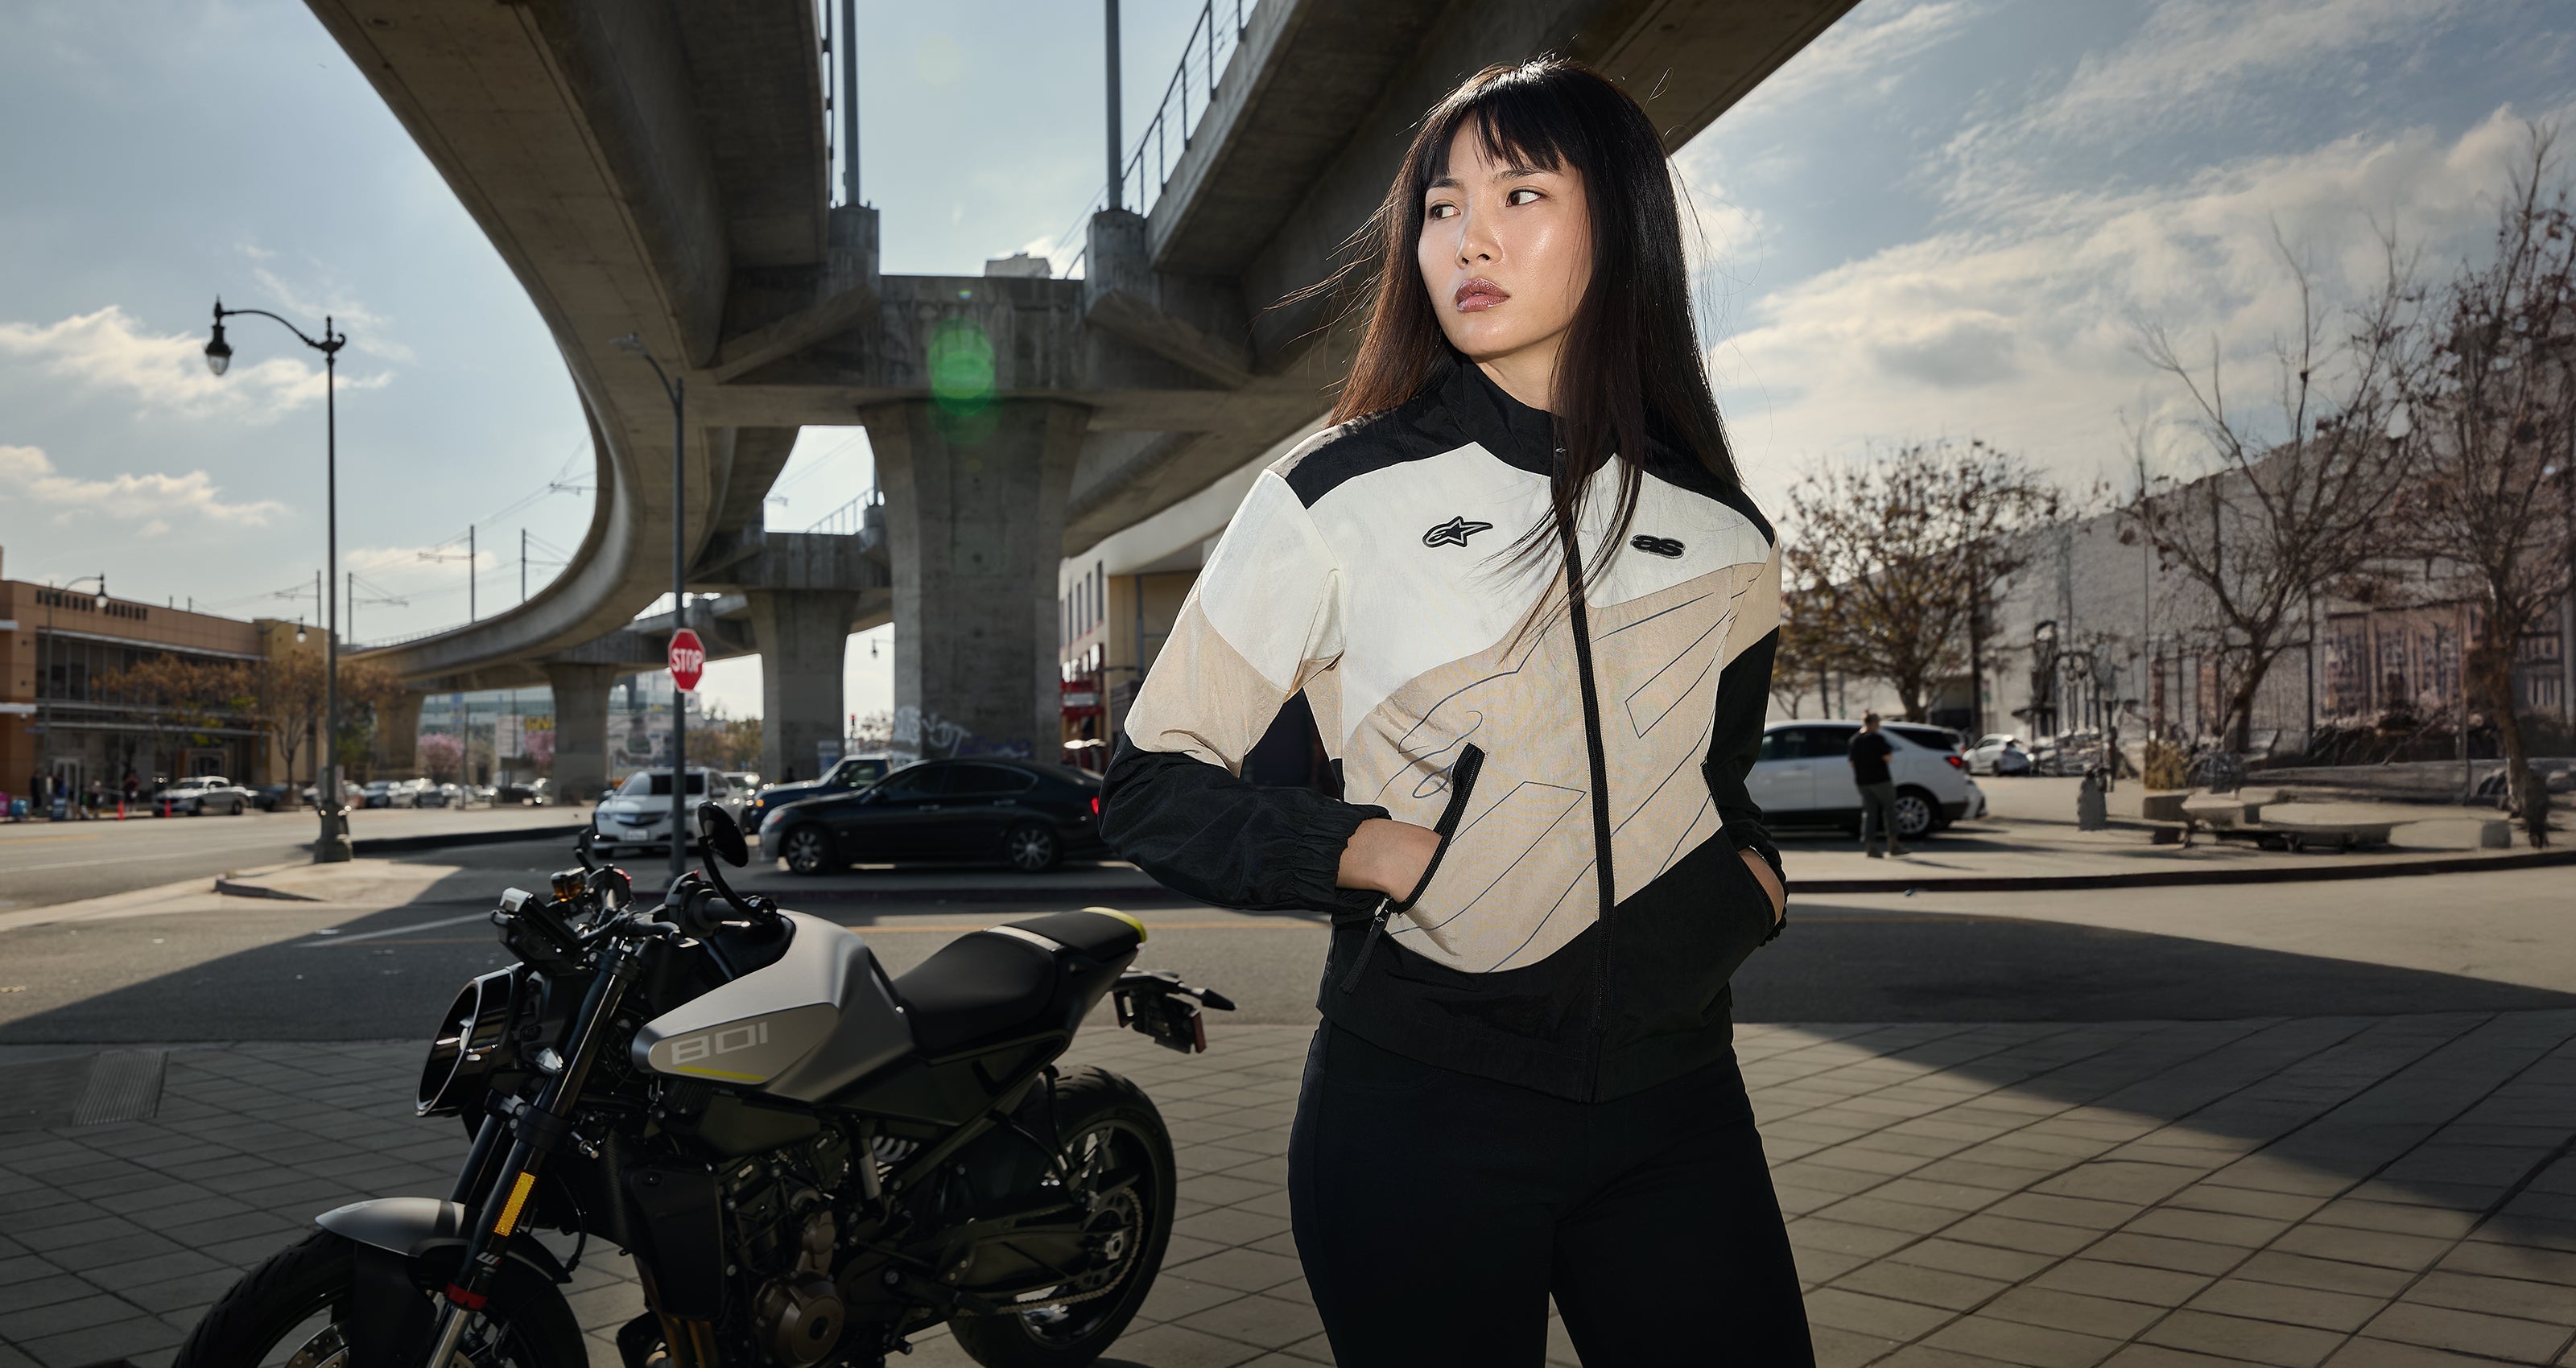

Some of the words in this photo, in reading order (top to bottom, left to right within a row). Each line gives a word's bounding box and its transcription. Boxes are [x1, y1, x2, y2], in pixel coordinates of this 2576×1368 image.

[1631, 534, 1685, 558] as
[671, 648, 704, 674] STOP
[671, 1021, 768, 1065] 801
